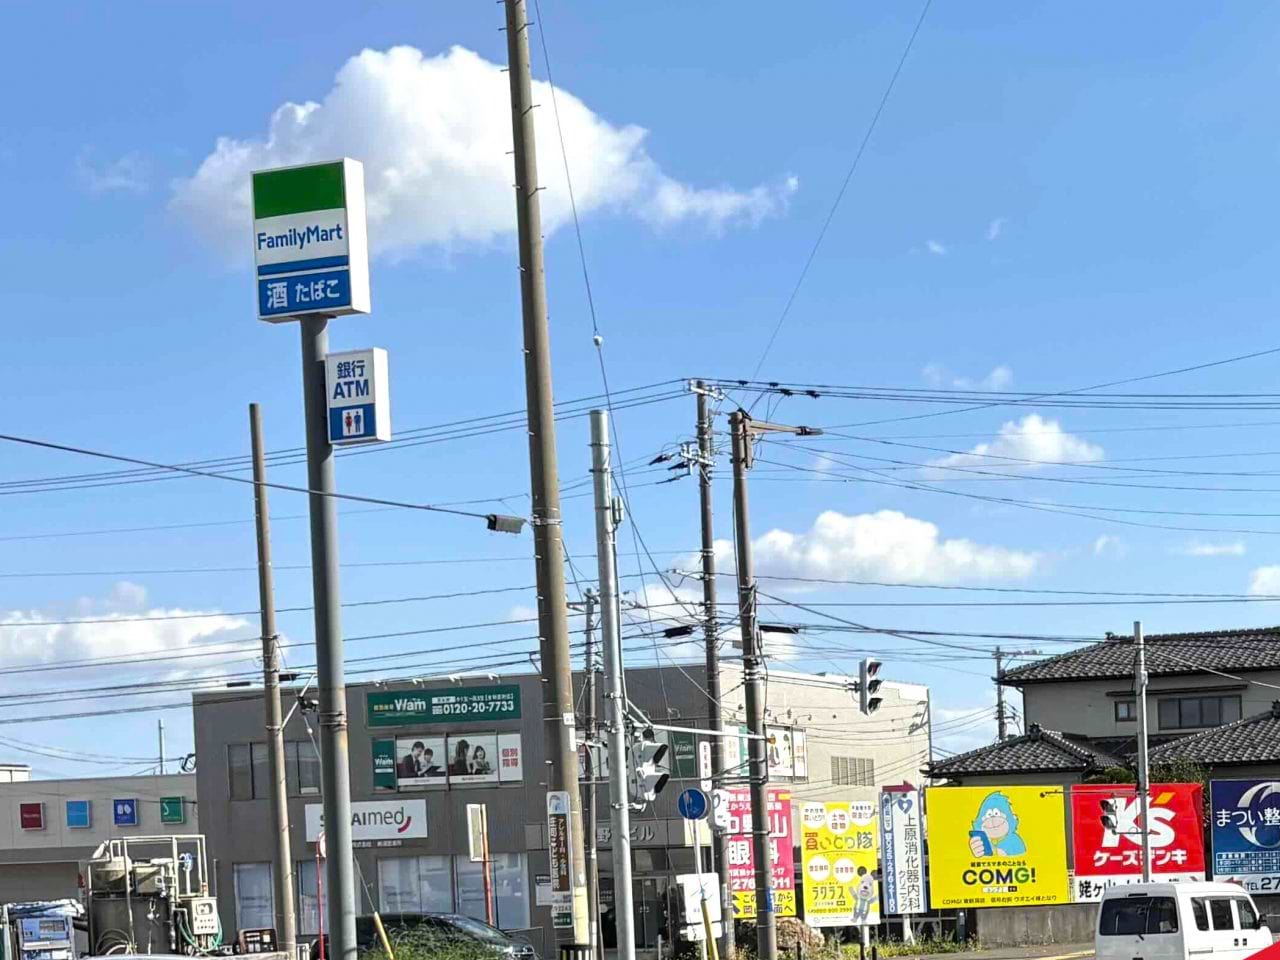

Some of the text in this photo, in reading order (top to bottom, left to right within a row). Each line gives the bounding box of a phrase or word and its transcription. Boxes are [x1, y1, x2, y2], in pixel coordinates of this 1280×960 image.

[257, 222, 343, 250] FamilyMart
[266, 279, 341, 308] 酒 たばこ
[336, 360, 366, 379] 銀行
[333, 379, 370, 400] ATM
[804, 831, 873, 850] 買いとり隊
[904, 813, 920, 911] 上原消化器内科
[962, 867, 1036, 885] COMG!
[898, 870, 908, 912] クリニック
